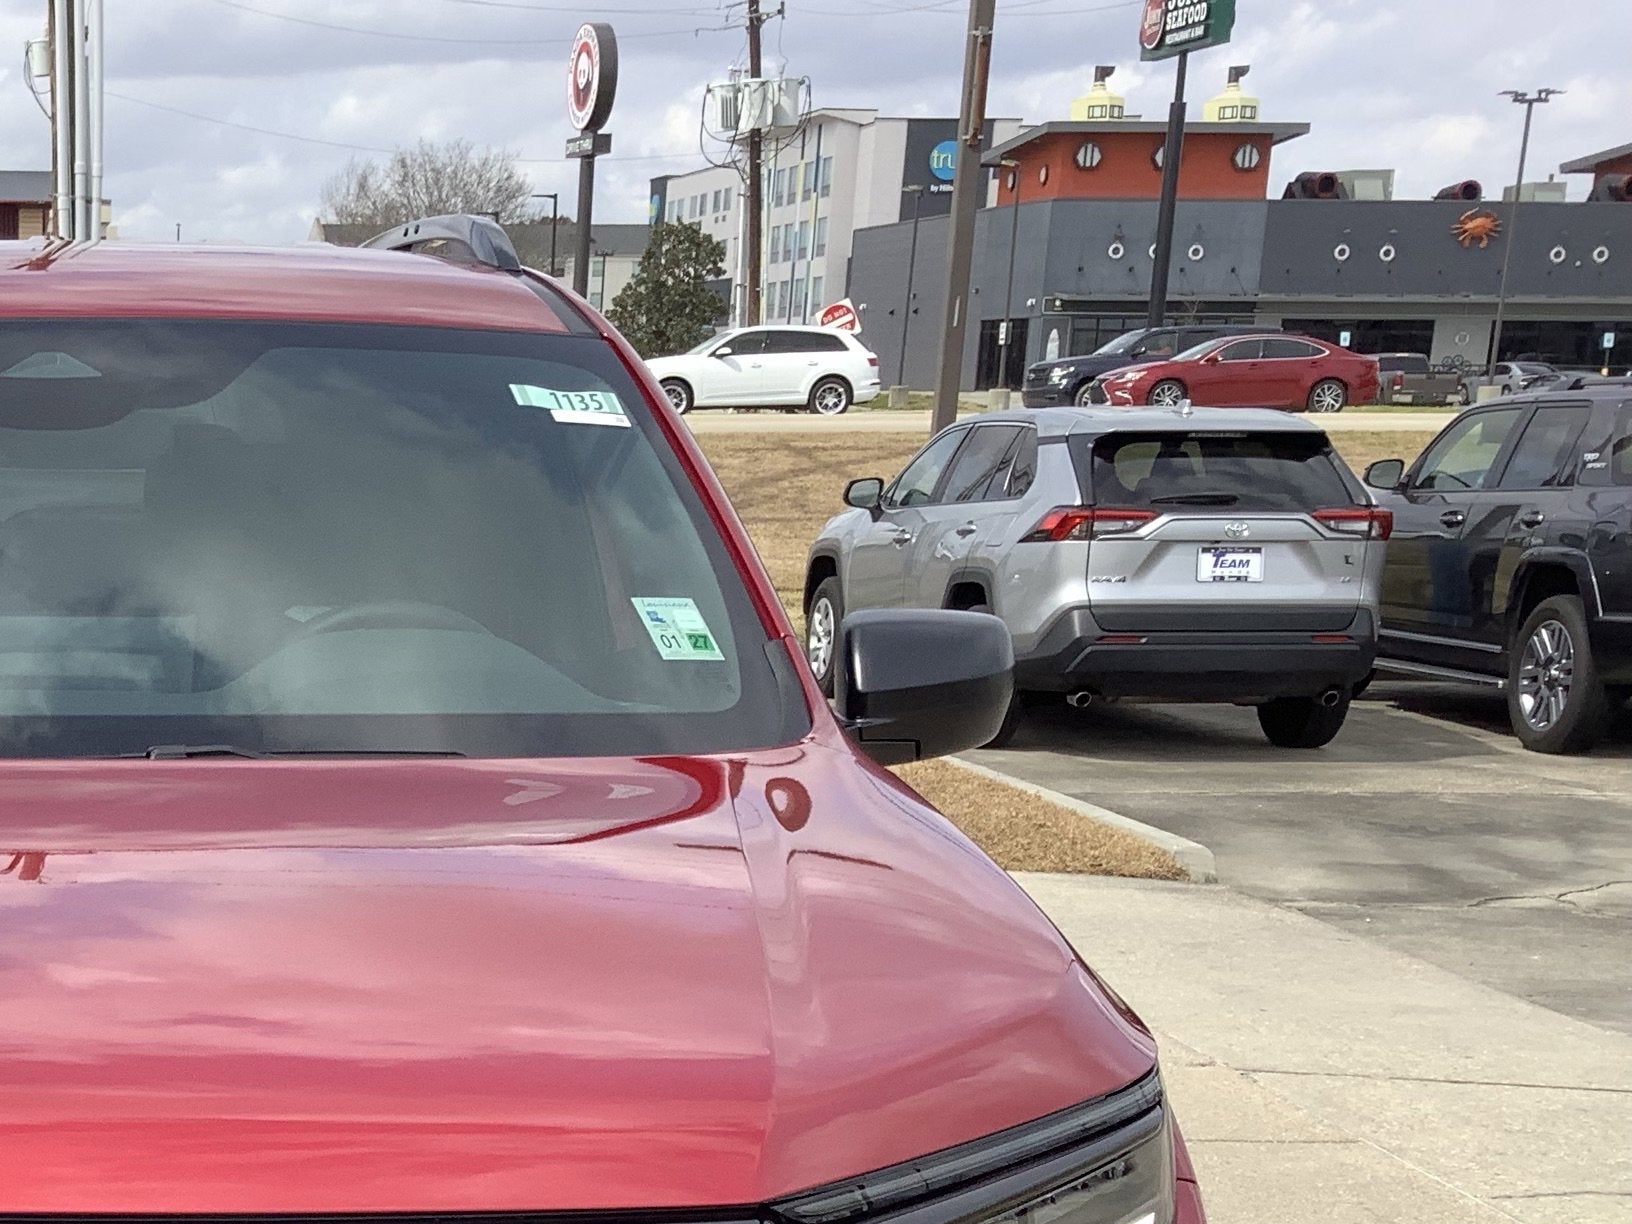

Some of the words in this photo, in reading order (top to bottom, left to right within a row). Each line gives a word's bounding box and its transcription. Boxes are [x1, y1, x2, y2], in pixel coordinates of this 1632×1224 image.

[1165, 2, 1207, 31] SEAFOOD
[822, 314, 833, 324] DO
[833, 307, 847, 319] NOT
[549, 392, 604, 411] 1135
[660, 634, 682, 649] 01
[687, 634, 709, 649] 27
